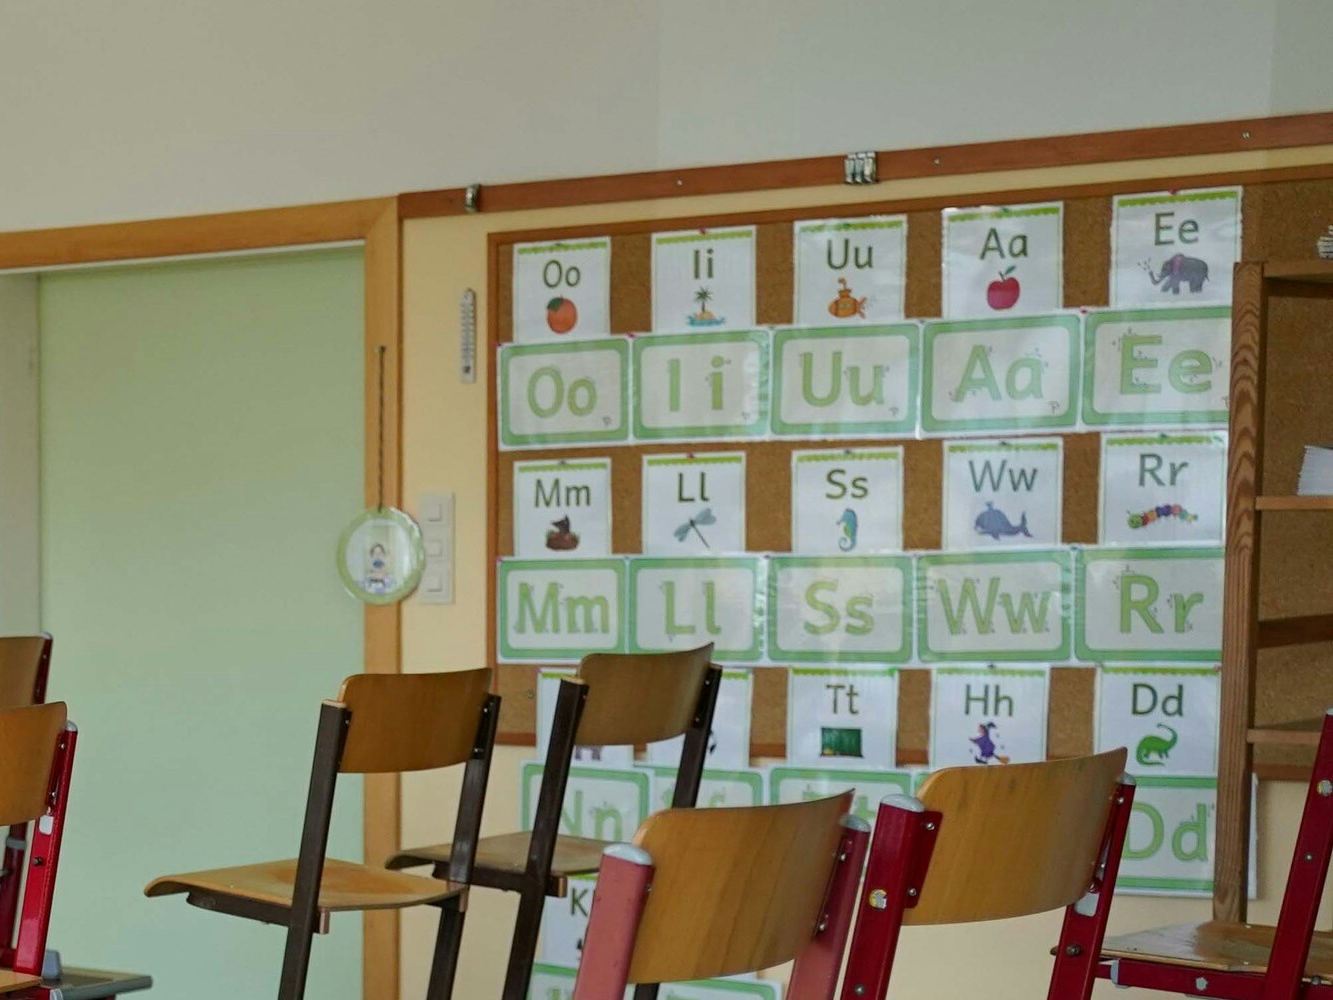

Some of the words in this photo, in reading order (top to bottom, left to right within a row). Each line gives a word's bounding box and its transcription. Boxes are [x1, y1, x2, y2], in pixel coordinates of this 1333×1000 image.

[979, 227, 1029, 260] Aa
[1154, 212, 1199, 246] Ee
[693, 248, 714, 280] Ii
[826, 238, 873, 270] Uu
[543, 259, 581, 288] Oo
[801, 350, 885, 408] Uu
[954, 344, 1044, 402] Aa
[1120, 334, 1213, 395] Ee
[527, 366, 597, 418] Oo
[825, 469, 869, 500] Ss
[969, 459, 1038, 493] Ww
[1137, 452, 1189, 487] Rr
[534, 478, 591, 508] Mm
[677, 472, 710, 503] Ll
[516, 581, 610, 635] Mm
[664, 581, 722, 636] Ll
[803, 580, 874, 636] Ss
[937, 576, 1051, 635] Ww
[1119, 573, 1204, 634] Rr
[825, 684, 859, 716] Tt
[963, 683, 1014, 717] Hh
[1131, 683, 1184, 718] Dd
